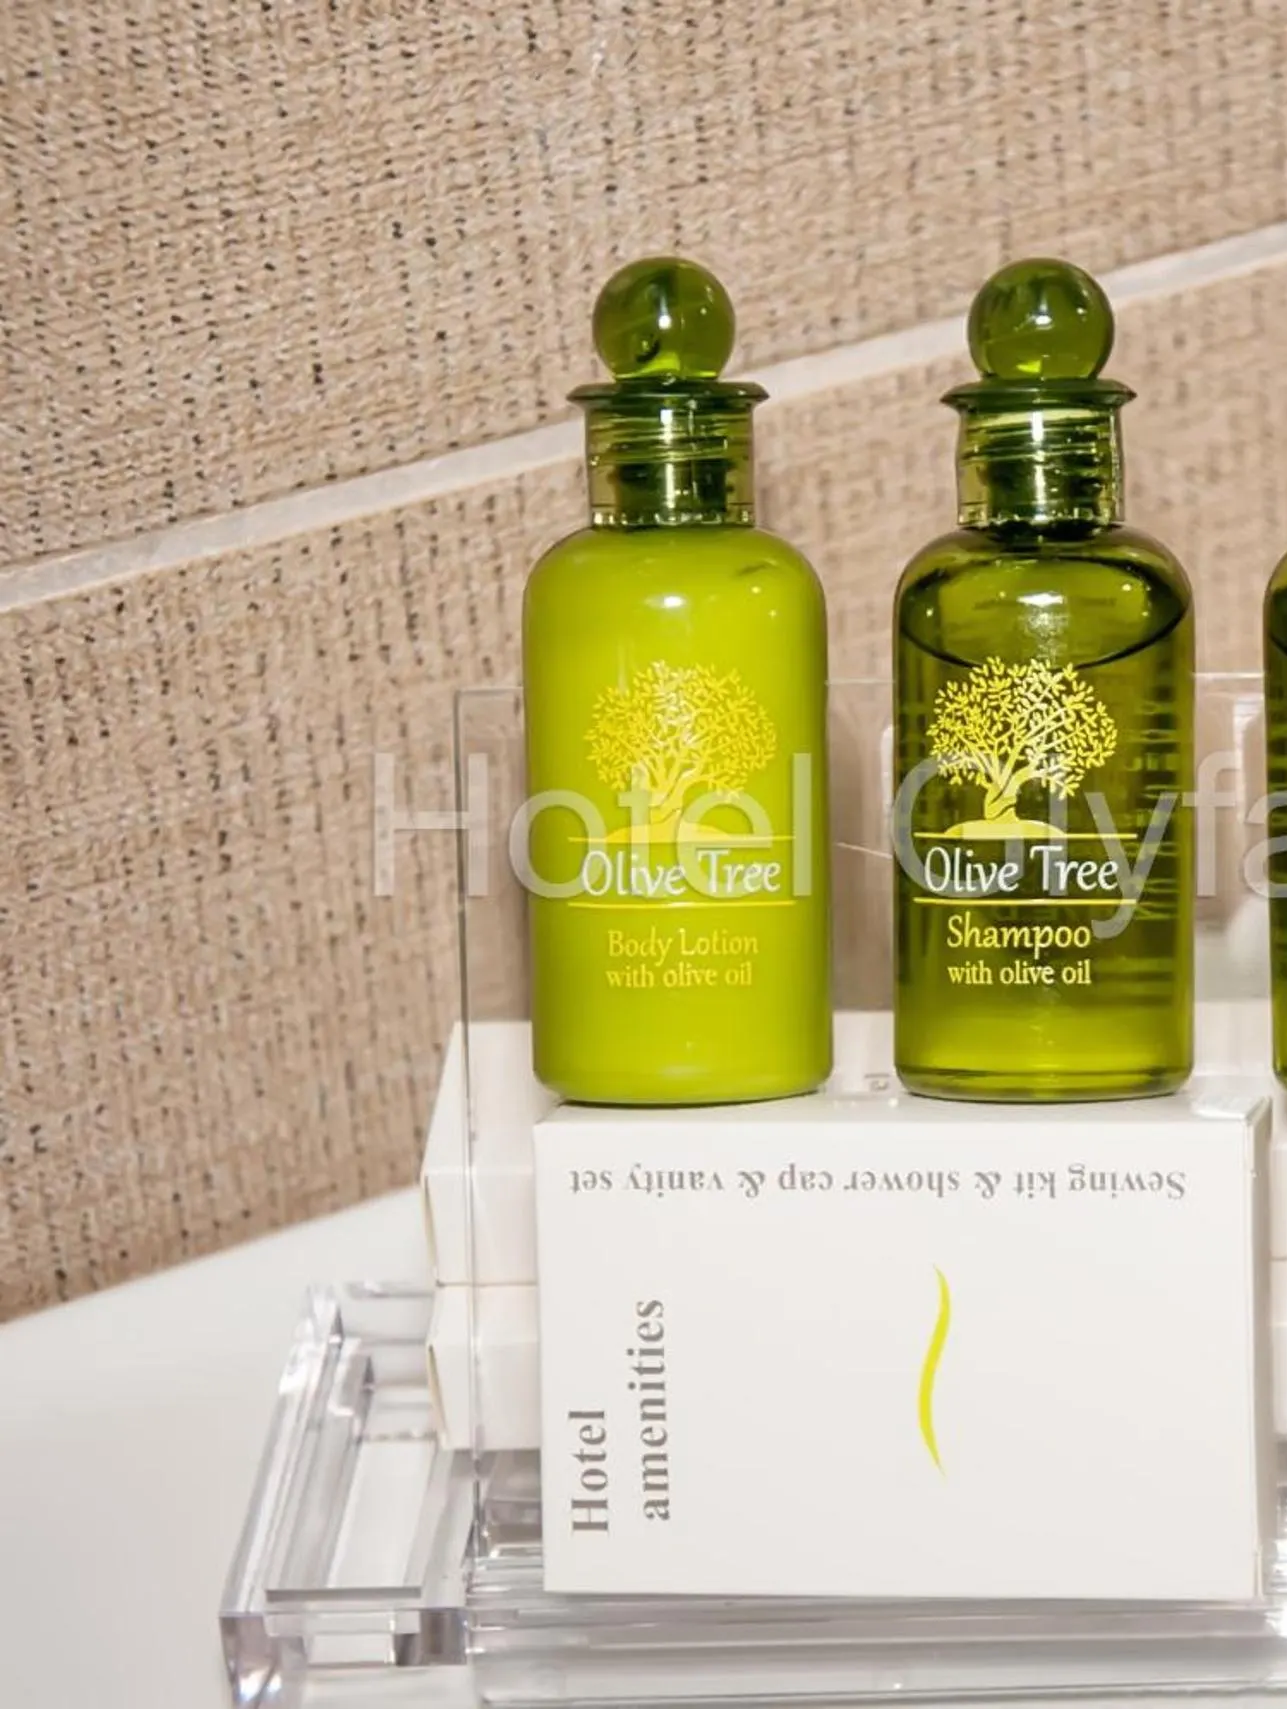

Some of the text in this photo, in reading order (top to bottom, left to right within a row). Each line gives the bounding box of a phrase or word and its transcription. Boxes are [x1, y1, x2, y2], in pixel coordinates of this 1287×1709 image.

[582, 849, 782, 897] Olive Tree
[924, 845, 1119, 892] Olive Tree
[607, 926, 759, 967] Body Lotion
[946, 911, 1092, 960] Shampoo
[606, 960, 753, 988] with olive oil
[947, 958, 1092, 985] with olive oil
[570, 1163, 1187, 1200] Sewing kit & shower cap & vanity set
[625, 1299, 671, 1522] amenities
[567, 1410, 610, 1534] Hotel
